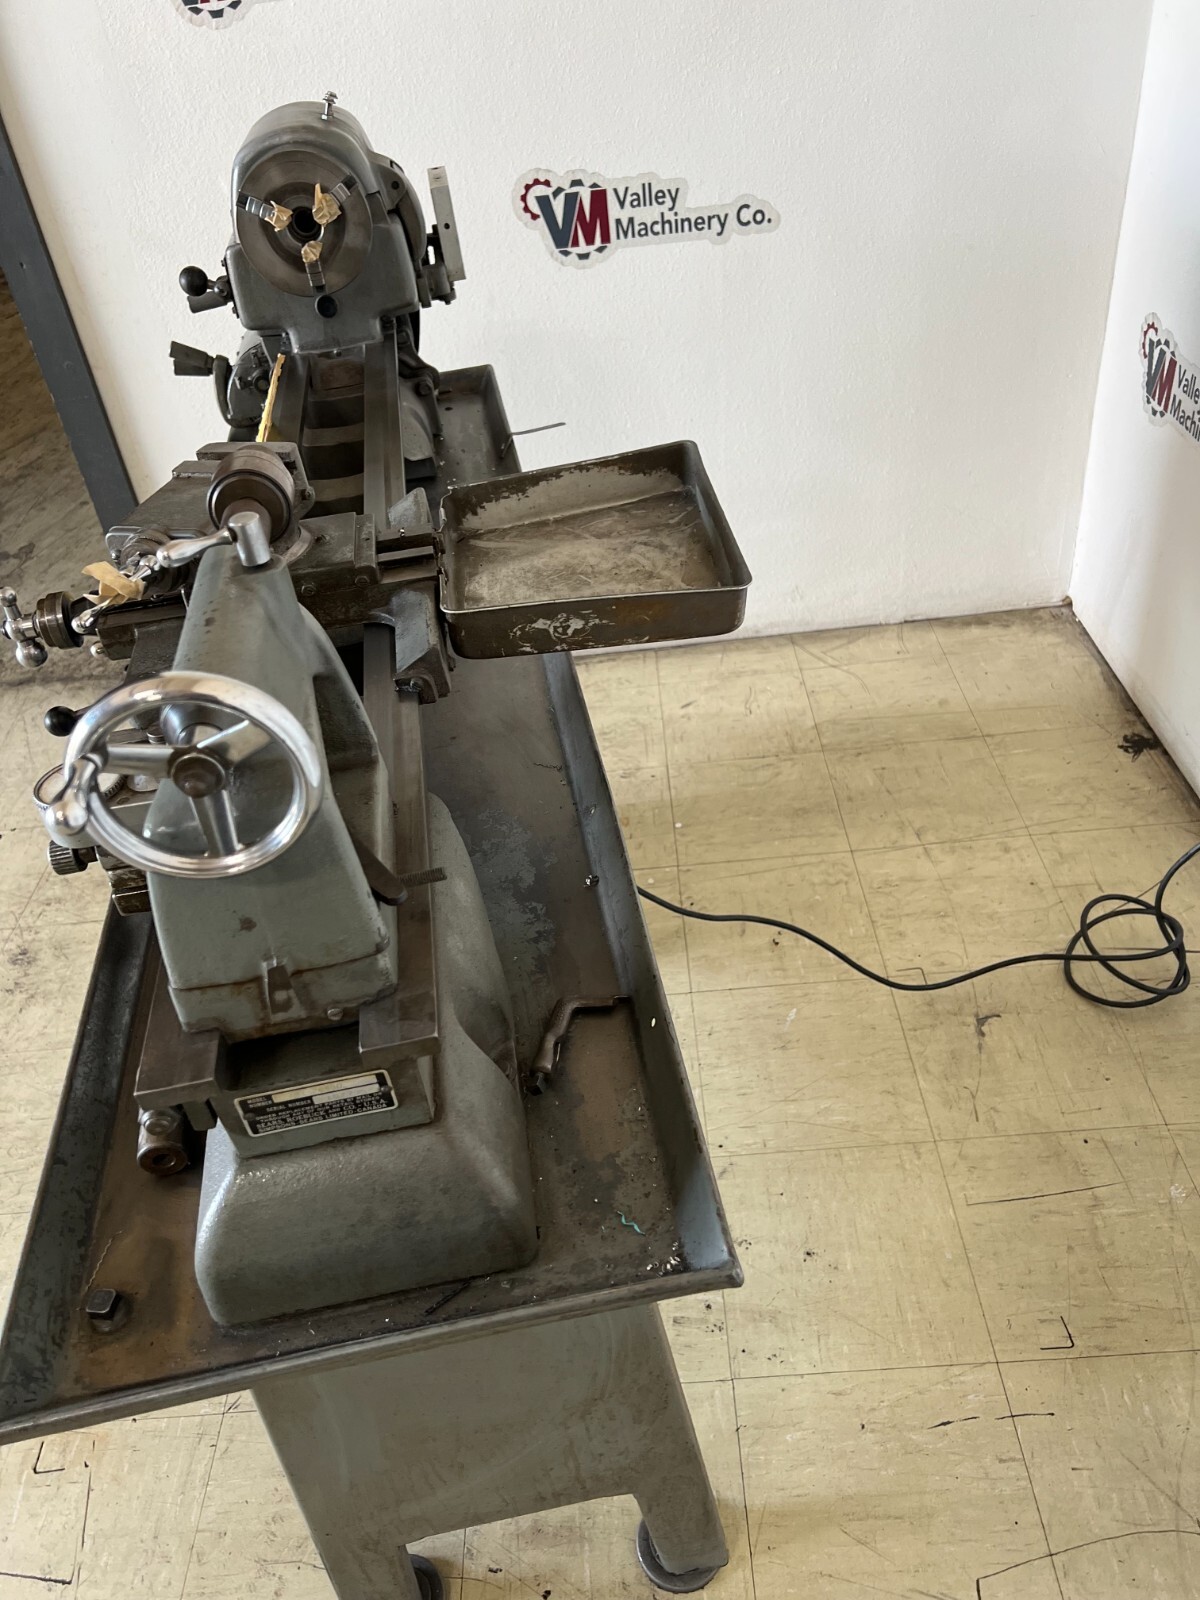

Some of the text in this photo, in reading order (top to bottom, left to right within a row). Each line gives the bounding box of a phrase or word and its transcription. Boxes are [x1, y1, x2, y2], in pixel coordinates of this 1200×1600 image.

[613, 182, 680, 211] Valley
[535, 188, 611, 249] VM
[614, 203, 772, 240] Machinery Co.
